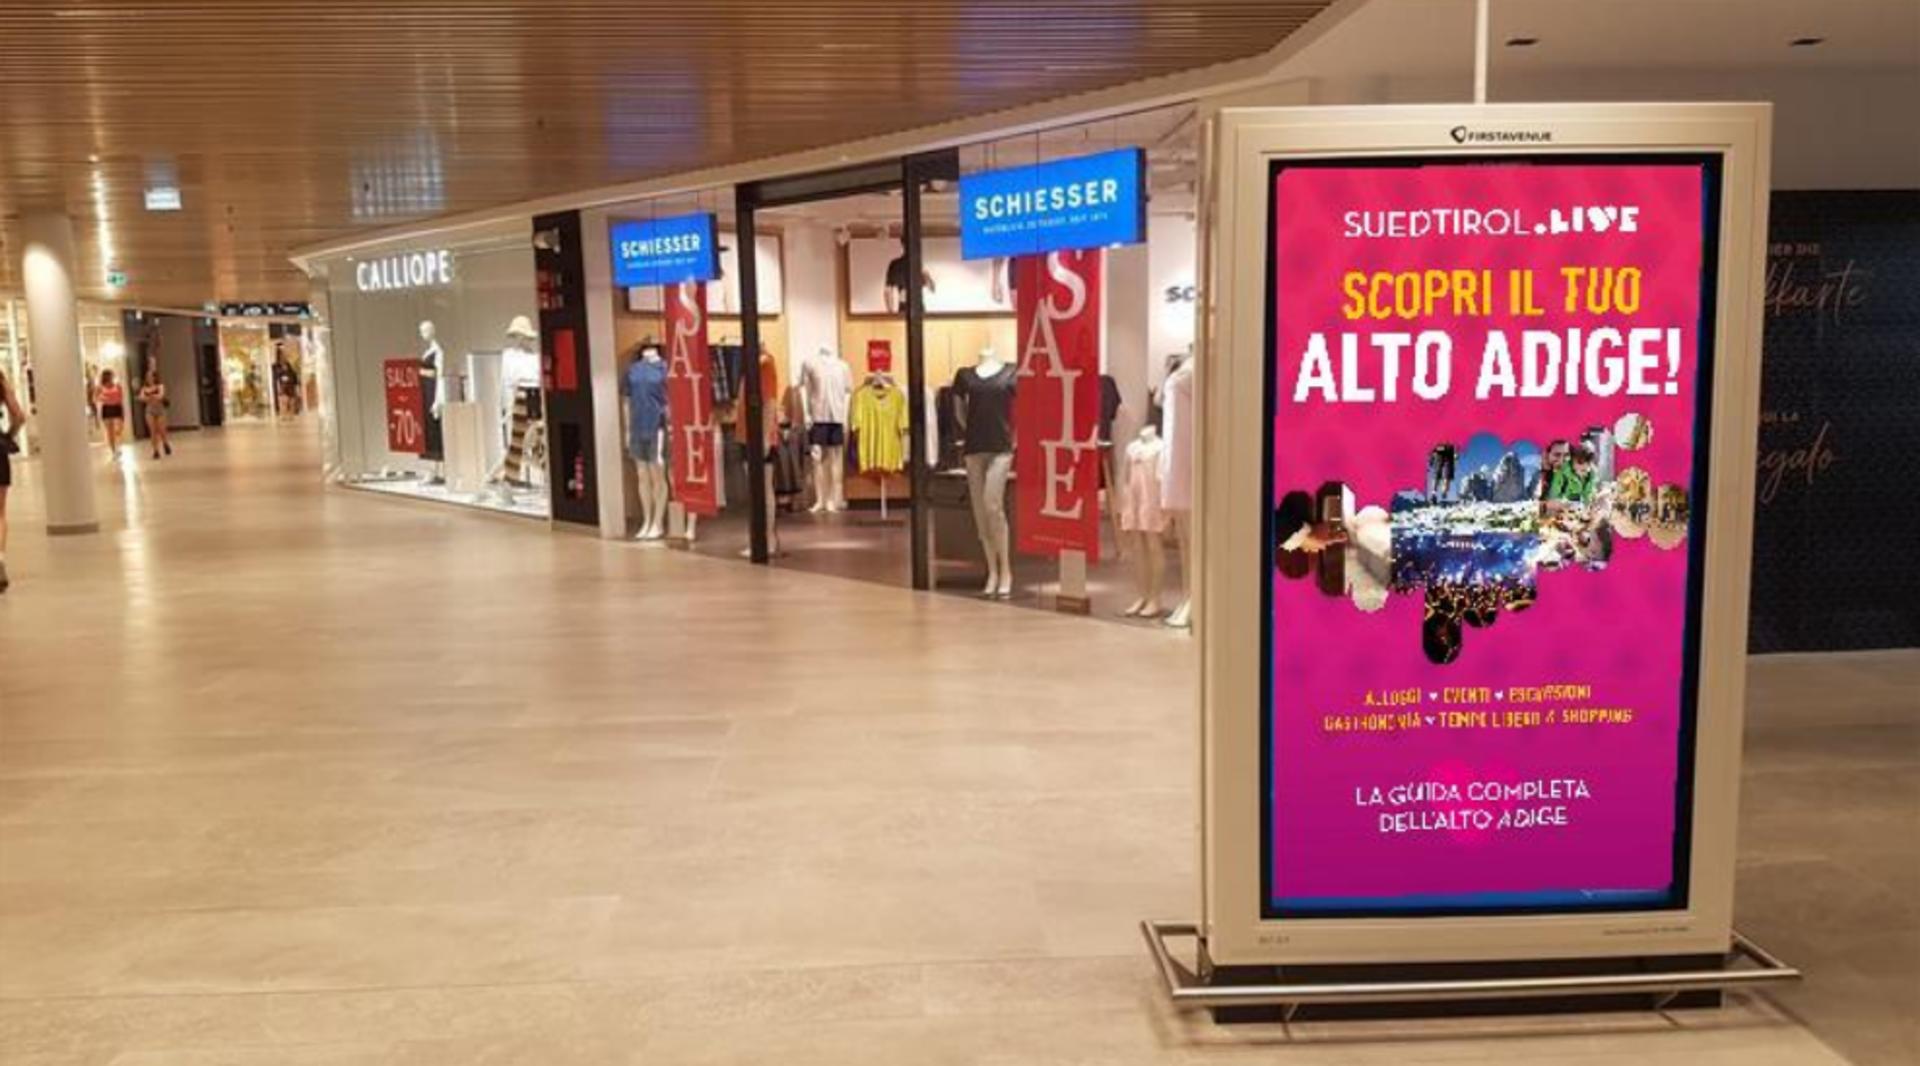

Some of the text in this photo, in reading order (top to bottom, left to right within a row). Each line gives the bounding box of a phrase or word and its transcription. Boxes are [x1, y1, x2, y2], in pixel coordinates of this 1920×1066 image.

[974, 178, 1118, 220] SCHIESSER
[620, 233, 700, 259] SCHIESSER
[356, 249, 450, 290] CALLIOPE
[1343, 266, 1642, 320] SCOPRI IL TUO
[666, 276, 714, 483] SALE
[1016, 248, 1098, 520] SALE
[1293, 327, 1681, 402] ALTO ADIGE!
[1562, 708, 1633, 724] SHOPPING
[1355, 779, 1591, 806] LA GUIDA COMPLETA
[1379, 806, 1569, 833] DELL'ALTO ADIGE
